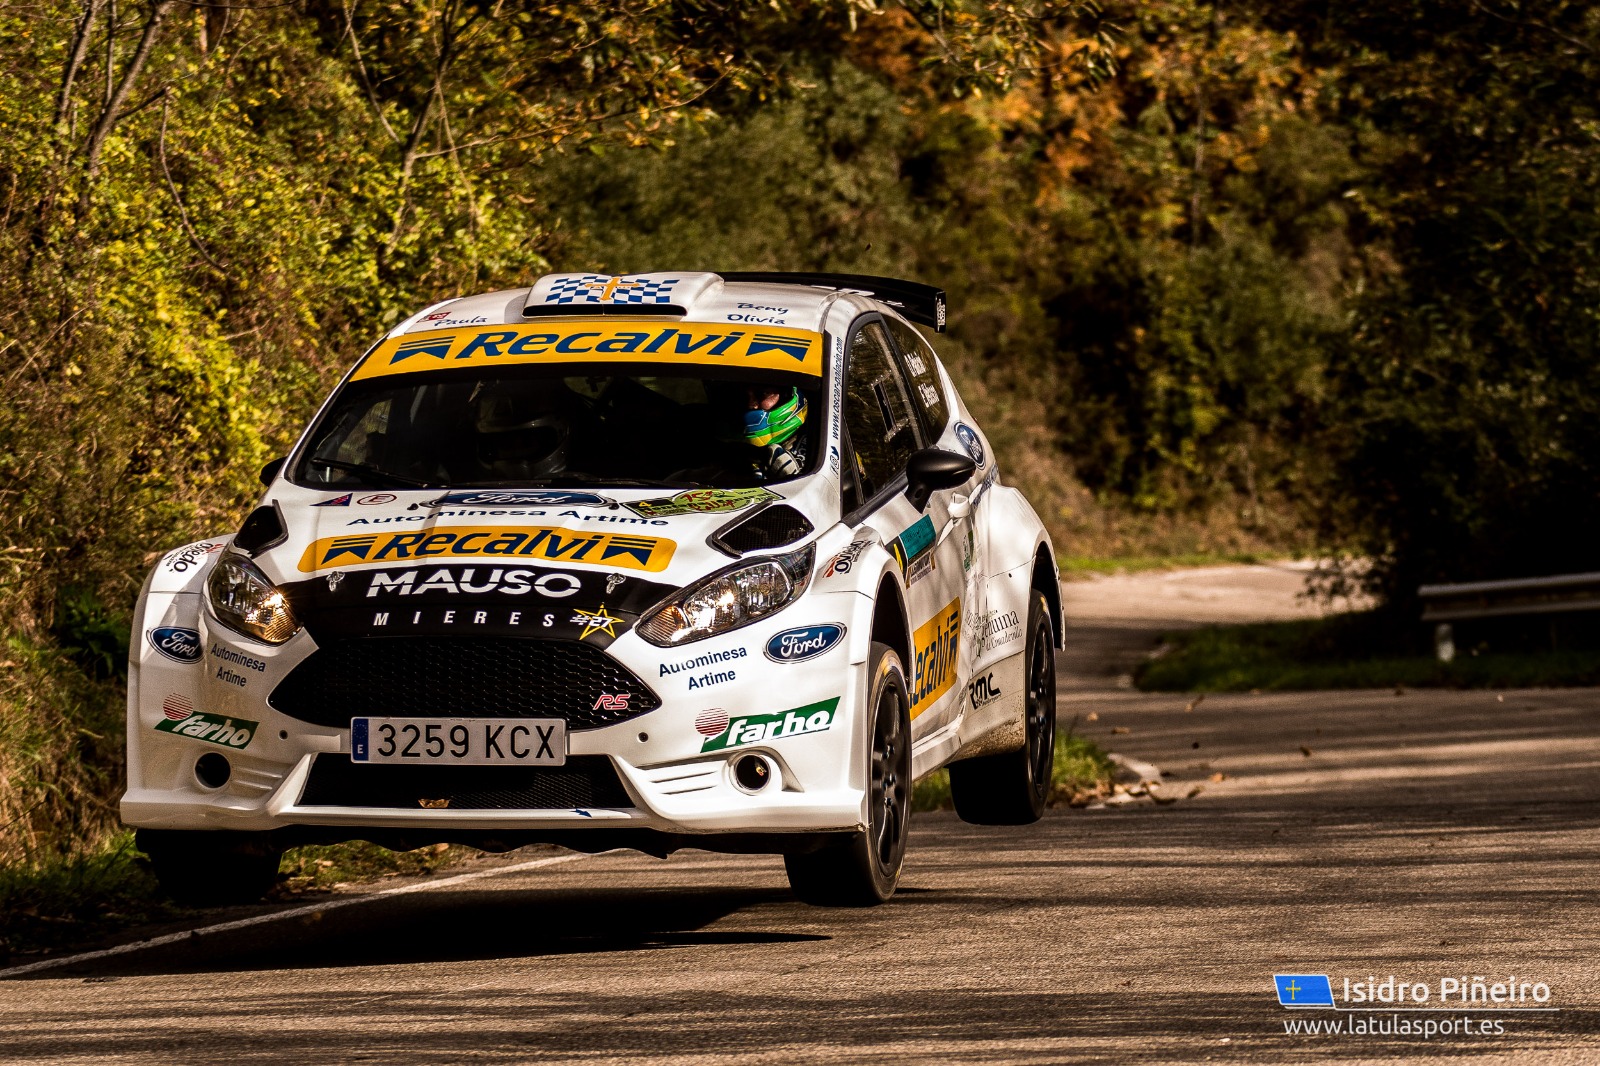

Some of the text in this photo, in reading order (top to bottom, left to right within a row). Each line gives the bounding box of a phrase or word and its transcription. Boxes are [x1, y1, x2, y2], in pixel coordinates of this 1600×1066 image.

[434, 315, 488, 327] Paula
[727, 313, 786, 325] Olivia
[737, 302, 789, 315] Beny
[455, 329, 745, 360] Recalvi
[463, 492, 573, 504] Ford
[346, 509, 669, 526] Autominesa Artime
[378, 529, 606, 560] Recalvi
[366, 568, 581, 597] MAUSO
[569, 614, 614, 628] #27
[162, 631, 199, 657] Ford
[780, 631, 826, 658] Ford
[211, 643, 266, 673] Autominesa
[659, 647, 747, 678] Autominesa
[216, 666, 247, 688] Artime
[688, 670, 736, 690] Artime
[593, 694, 631, 710] RS
[172, 714, 251, 746] farho
[726, 710, 831, 746] farho
[357, 724, 555, 759] E 3259 KCX
